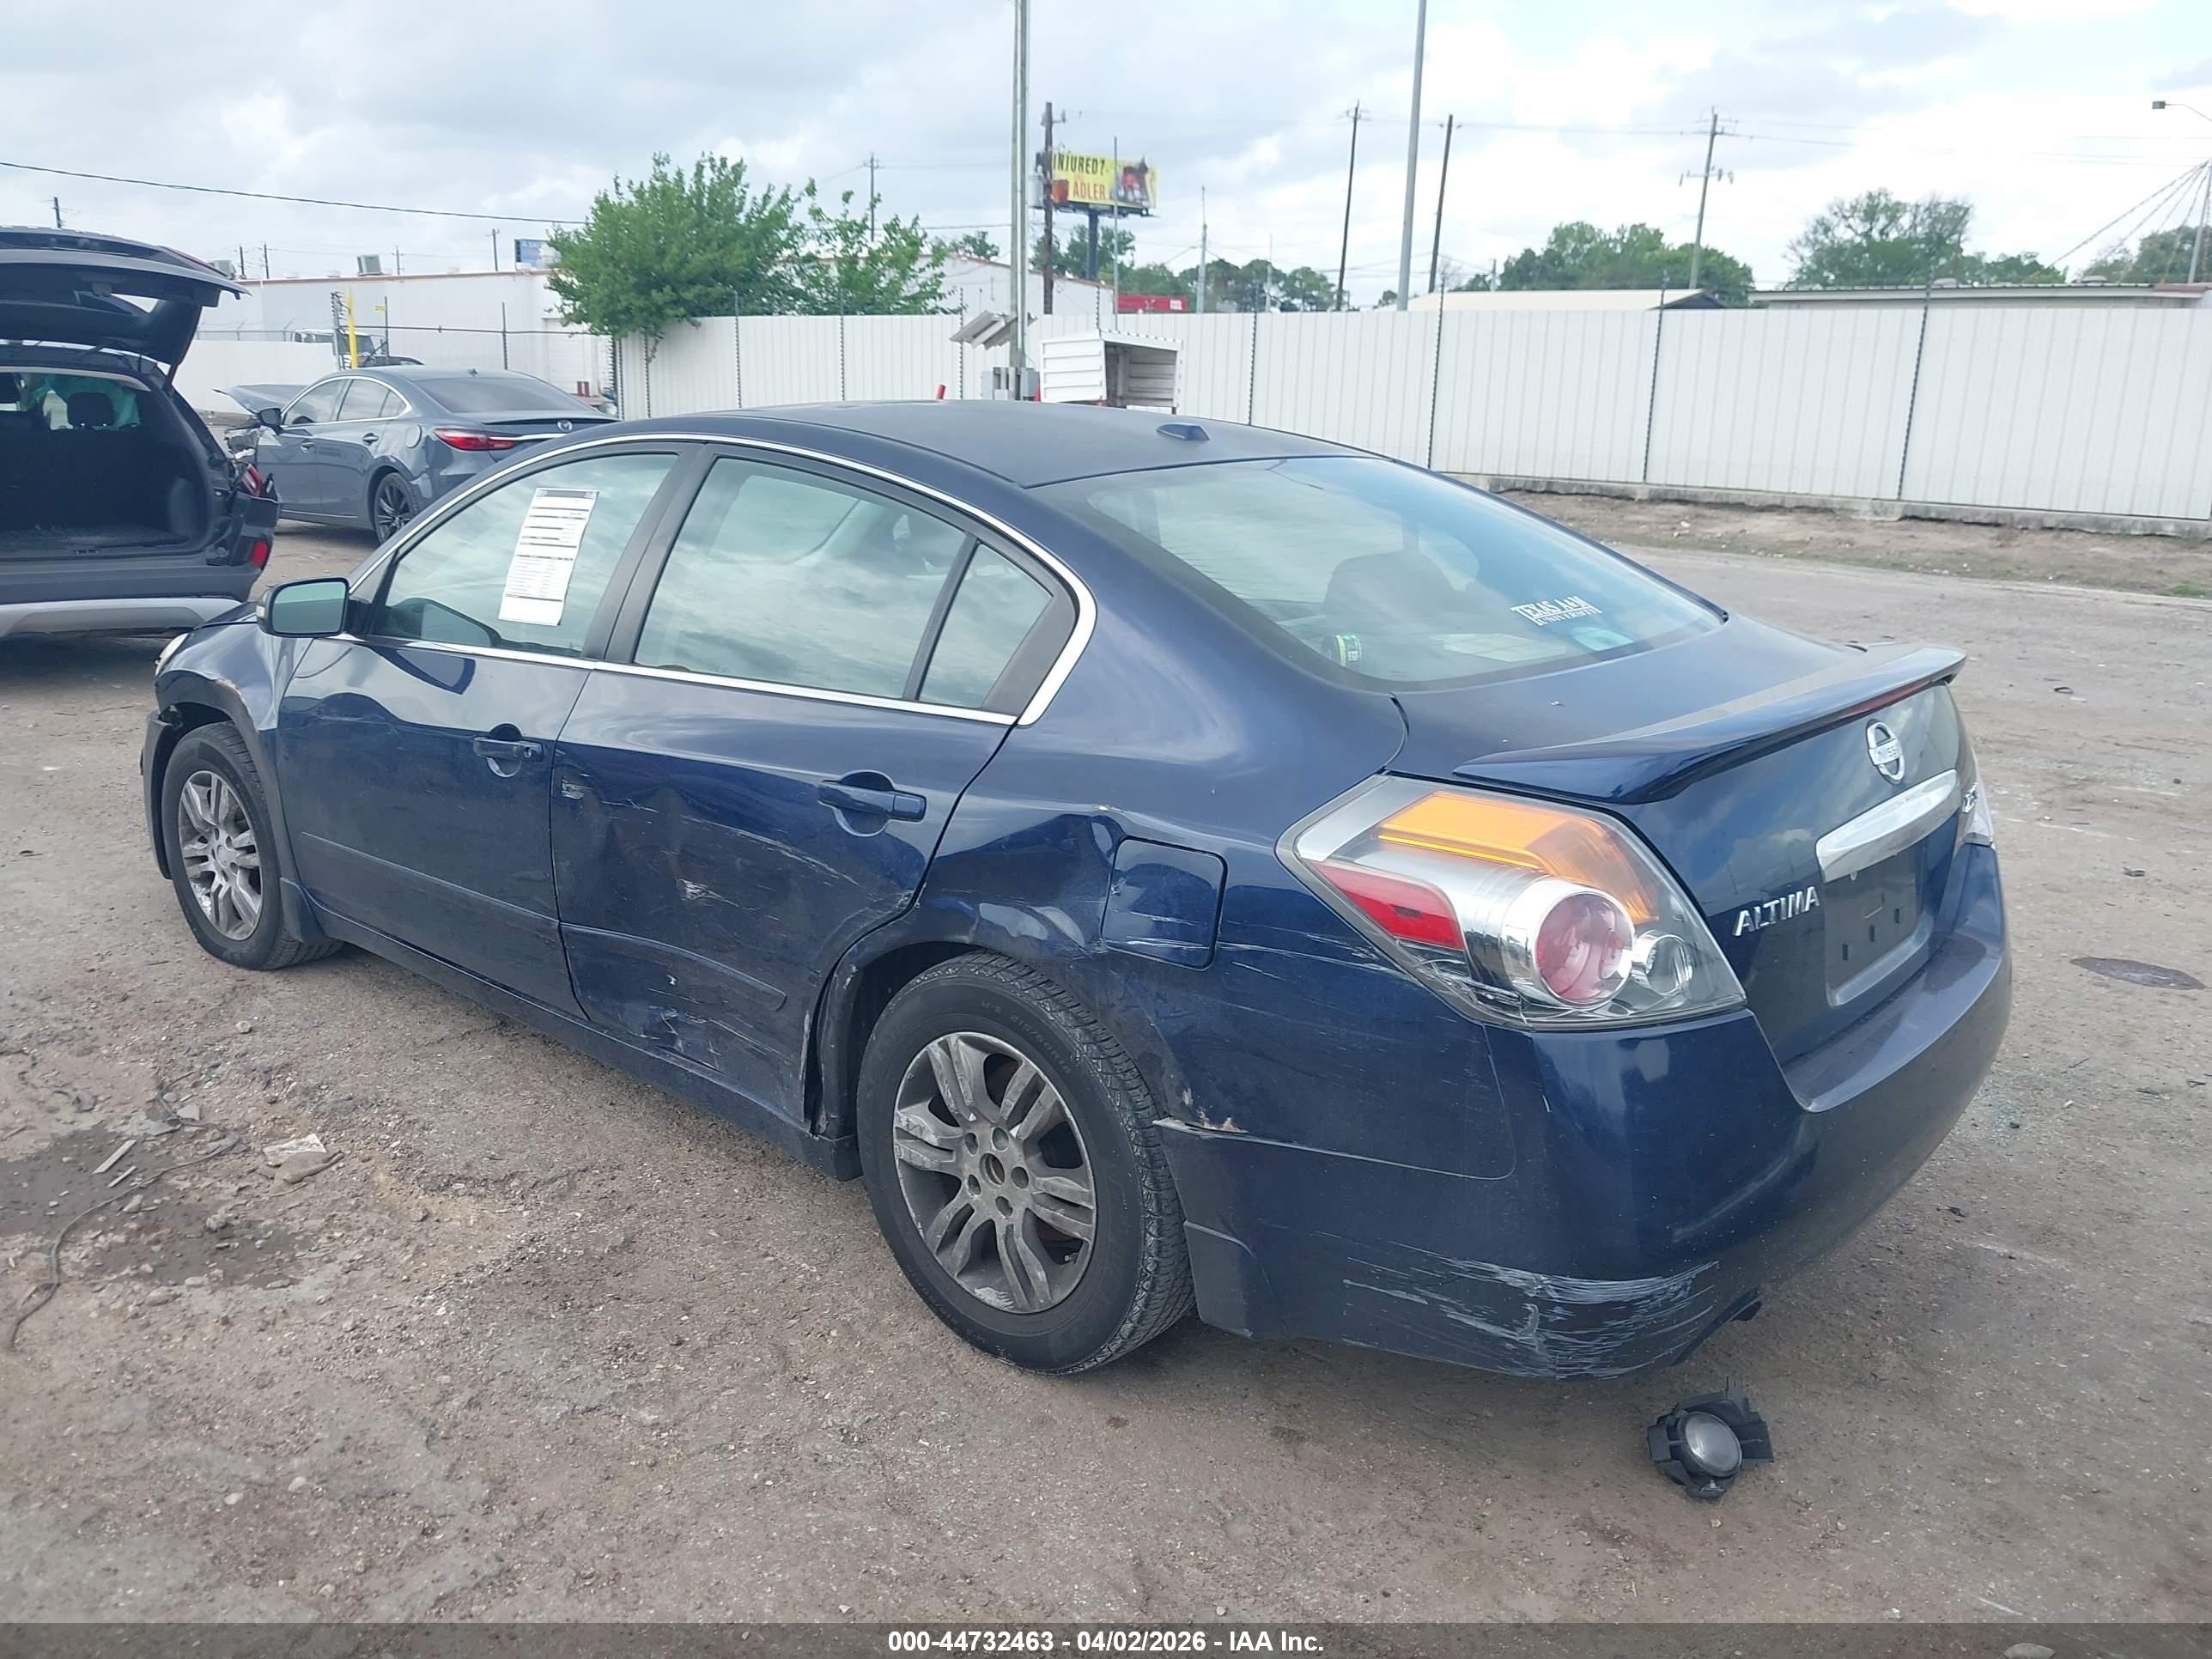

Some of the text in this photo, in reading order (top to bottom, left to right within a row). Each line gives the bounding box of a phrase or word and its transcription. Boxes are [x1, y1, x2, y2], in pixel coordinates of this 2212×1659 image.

[1053, 153, 1106, 176] INJURED?
[1073, 180, 1106, 200] ADLER
[1510, 600, 1561, 625] TEXAS
[1731, 885, 1820, 937] ALTIMA
